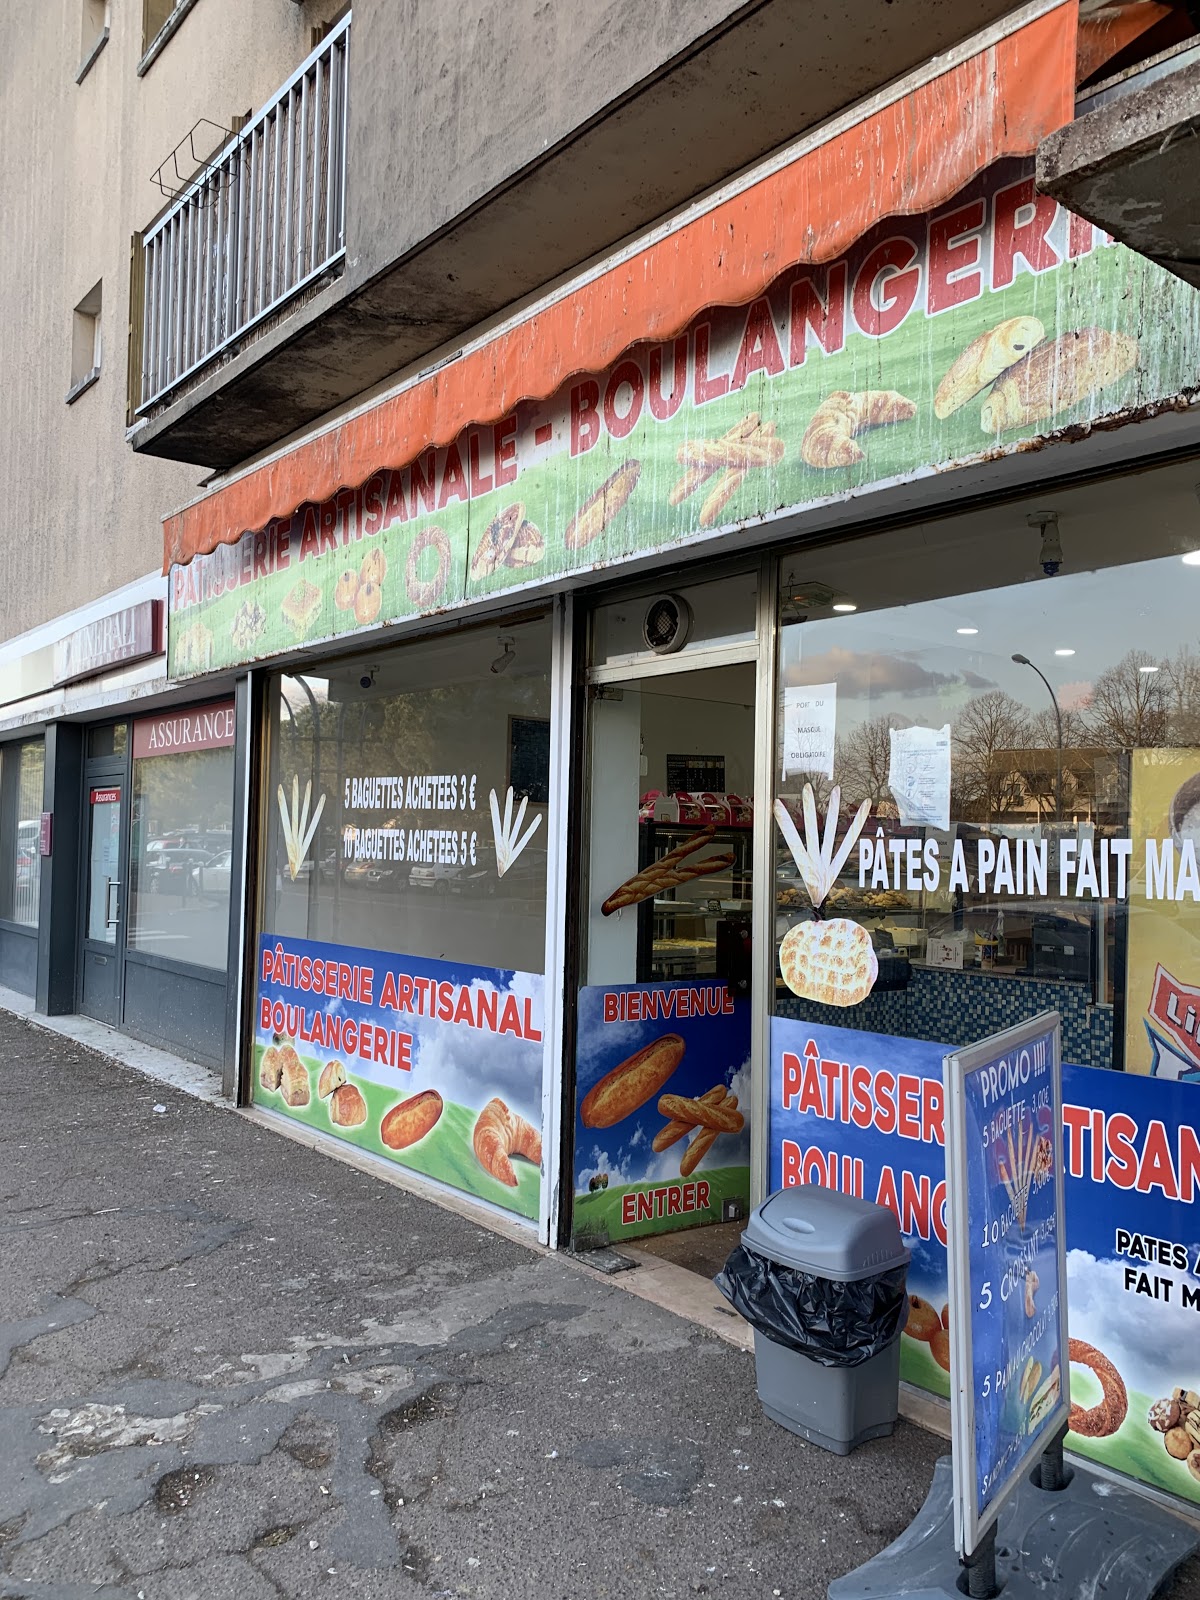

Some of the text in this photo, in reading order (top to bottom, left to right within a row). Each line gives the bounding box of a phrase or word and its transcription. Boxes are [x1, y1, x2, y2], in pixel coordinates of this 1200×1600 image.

[299, 413, 518, 562] ARTISANALE
[569, 174, 1118, 459] BOULANGER
[815, 700, 825, 708] DU
[148, 708, 235, 749] ASSURANCE
[797, 725, 821, 734] MASQUE
[790, 751, 826, 759] OBLIGATOIRE
[344, 774, 477, 810] 5 BAGUETTES ACHETEES 3 €
[354, 828, 405, 861] BAGUETTES
[406, 829, 458, 865] ACHETEES
[460, 830, 468, 866] 5
[469, 831, 477, 866] €
[858, 826, 1200, 902] PÂTES A PAIN FAIT MA
[262, 942, 543, 1043] PÂTISSERIE ARTISANAL
[604, 985, 735, 1024] BIENVENUE
[261, 996, 413, 1072] BOULANGERIE
[1165, 990, 1200, 1047] Li
[980, 1049, 1031, 1108] PROMO
[782, 1038, 1200, 1204] PÂTISSER TISAN
[982, 1125, 989, 1148] 5
[991, 1098, 1026, 1143] BAGUETTE
[622, 1180, 711, 1226] ENTRER
[981, 1220, 999, 1248] 10
[1115, 1227, 1189, 1271] PATES
[979, 1281, 993, 1310] 5
[1000, 1228, 1040, 1302] CROISSANT
[1124, 1267, 1174, 1303] FAIT
[981, 1374, 991, 1397] 5
[995, 1363, 1012, 1394] PAIN
